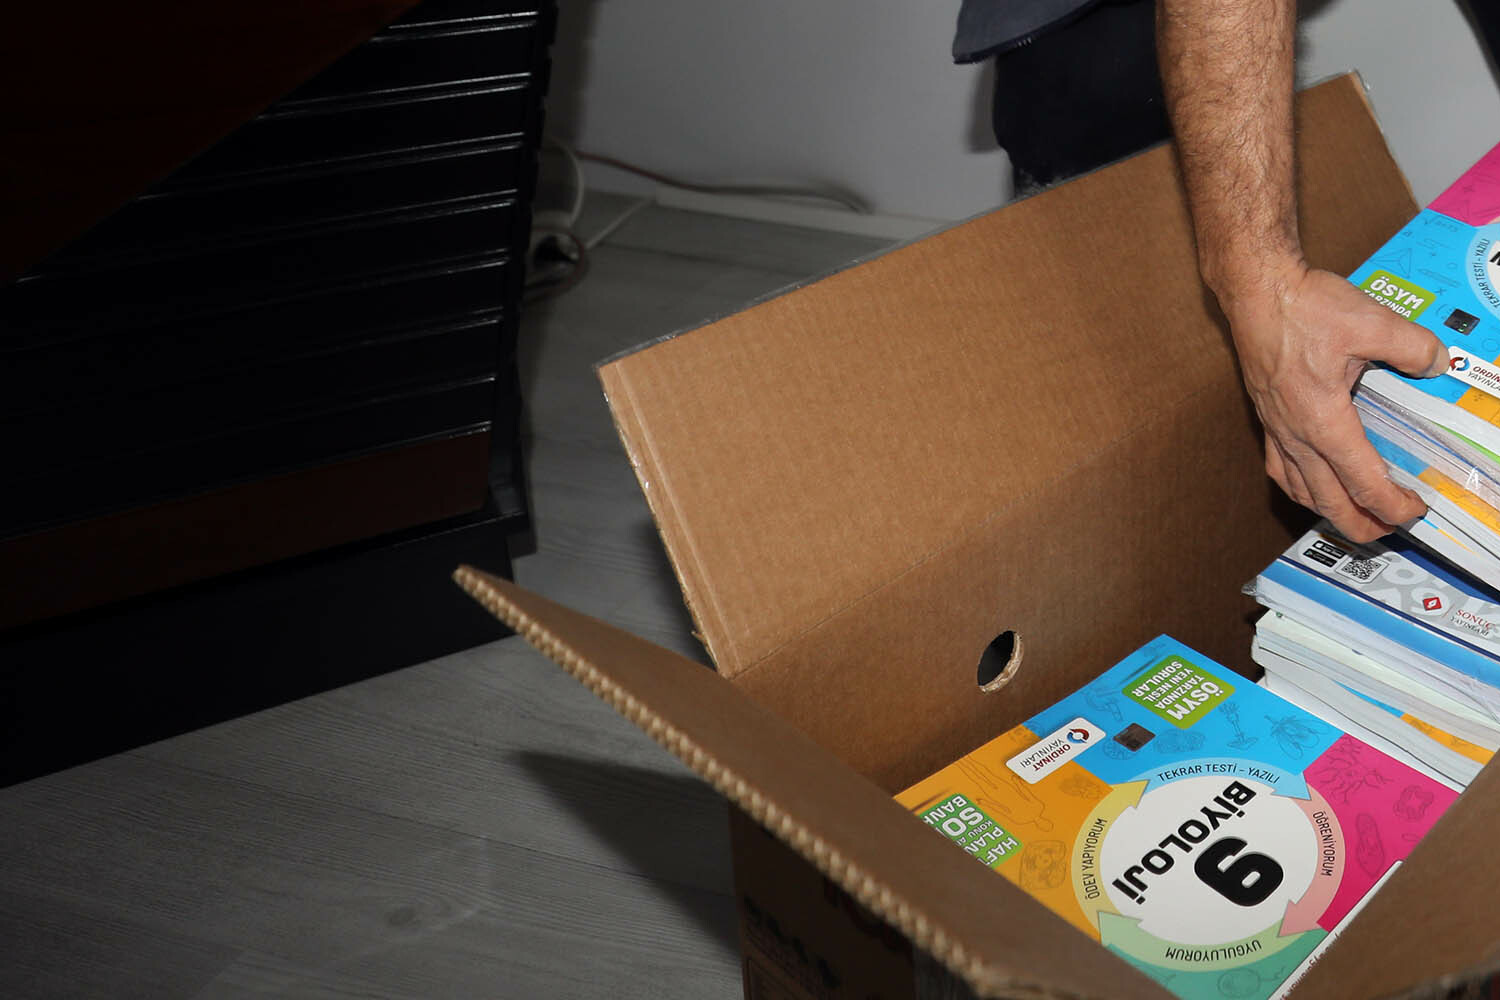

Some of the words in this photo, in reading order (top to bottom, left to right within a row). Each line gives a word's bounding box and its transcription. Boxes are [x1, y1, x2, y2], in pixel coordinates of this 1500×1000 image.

[1370, 275, 1425, 310] ÖSYM
[1131, 660, 1183, 697] SORULAR
[1154, 674, 1205, 710] TARZINDA
[1169, 668, 1194, 686] YENİ
[1166, 681, 1225, 721] ÖSYM
[1019, 738, 1064, 769] YAYINLARI
[1033, 743, 1072, 772] ORDİNAT
[1157, 763, 1203, 783] TEKRAR
[1205, 762, 1238, 774] TESTİ
[935, 806, 985, 839] SO
[968, 819, 993, 838] KONU
[1081, 817, 1108, 873] YAPIYORUM
[1111, 780, 1257, 906] BİYOLOJİ
[1312, 810, 1336, 877] ÖĞRENİYORUM
[1081, 873, 1101, 901] ÖDEV
[1193, 835, 1285, 908] 9
[1165, 938, 1262, 962] UYGULUYORUM
